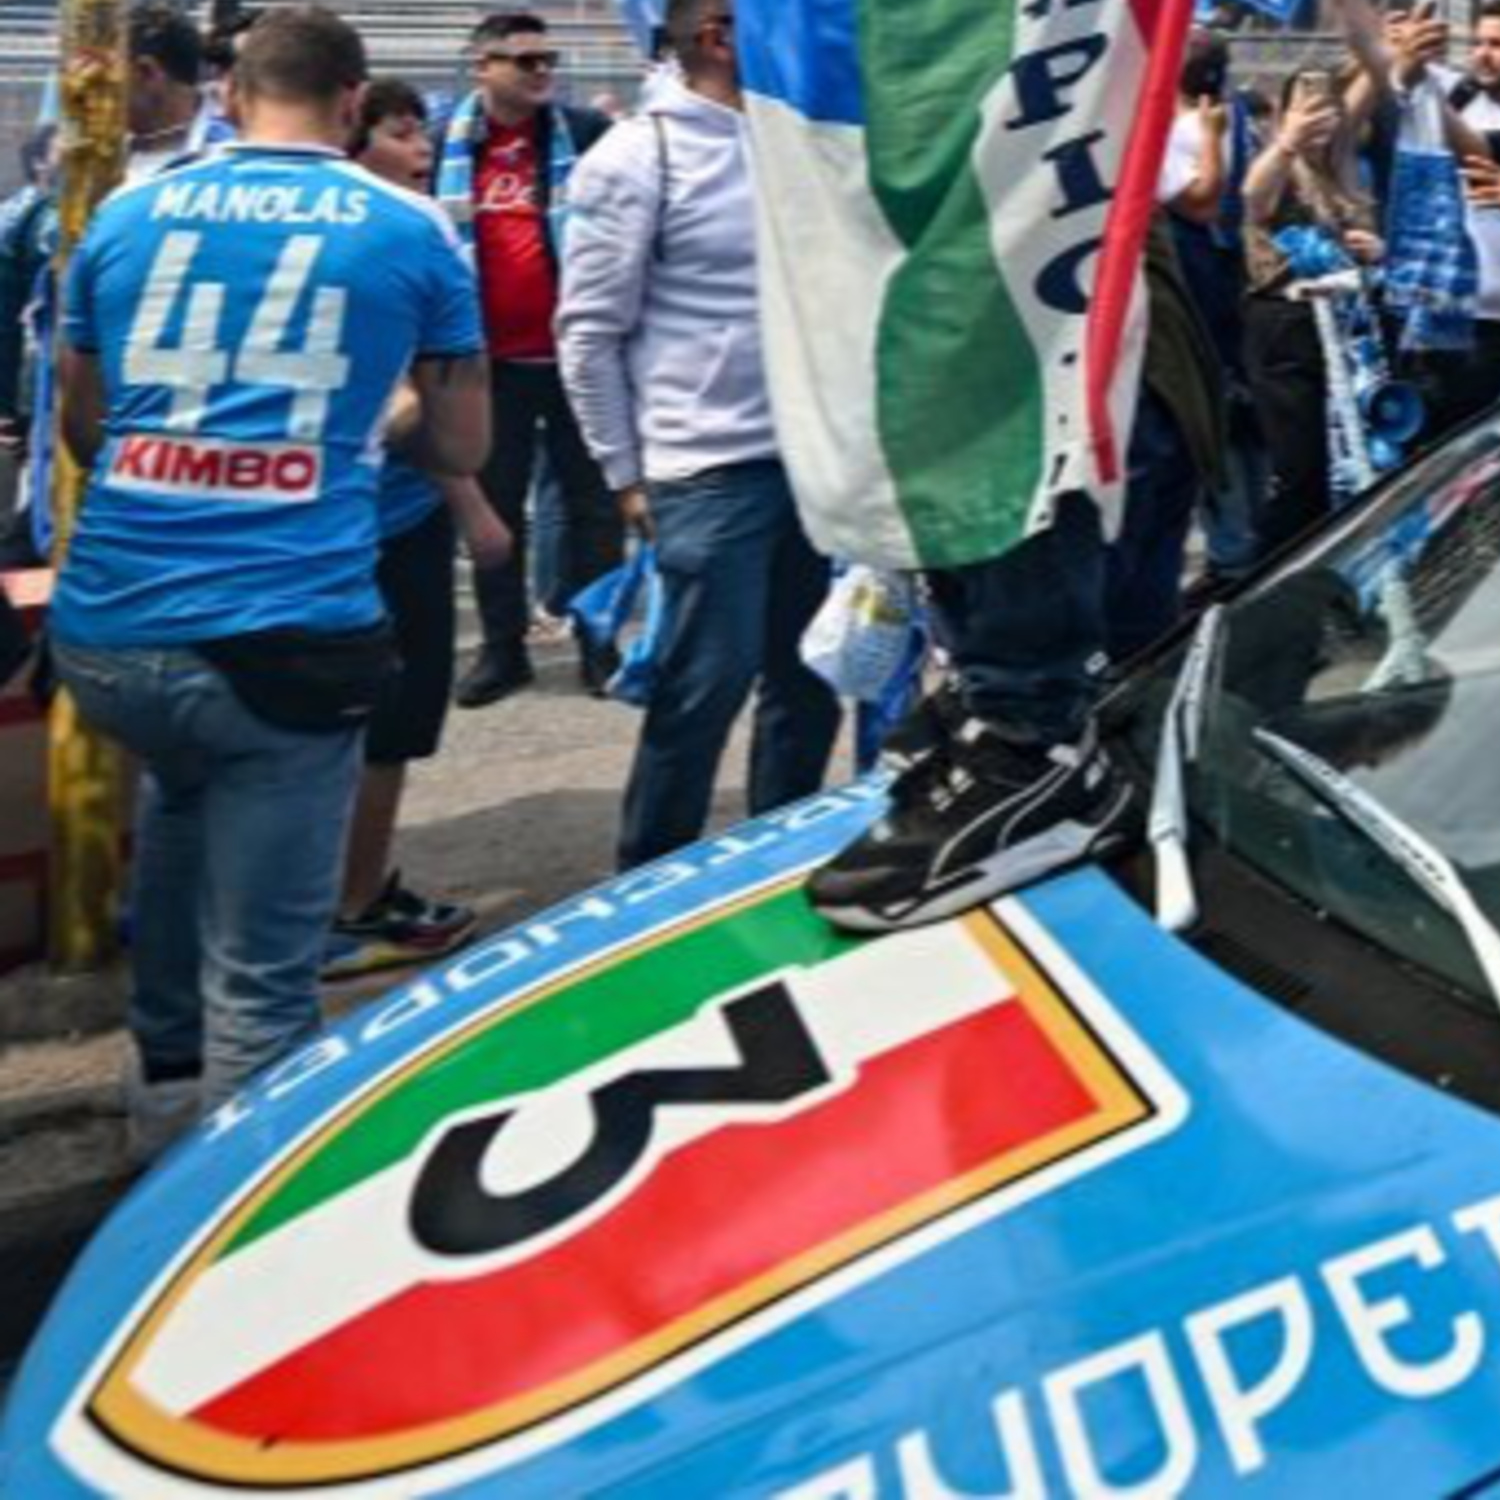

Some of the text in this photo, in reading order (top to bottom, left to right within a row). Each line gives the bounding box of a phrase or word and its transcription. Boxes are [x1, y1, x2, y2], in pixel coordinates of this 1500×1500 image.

[152, 182, 370, 222] MANOLAS
[121, 230, 350, 439] 44
[115, 437, 317, 491] KIMBO
[408, 979, 832, 1257] 3
